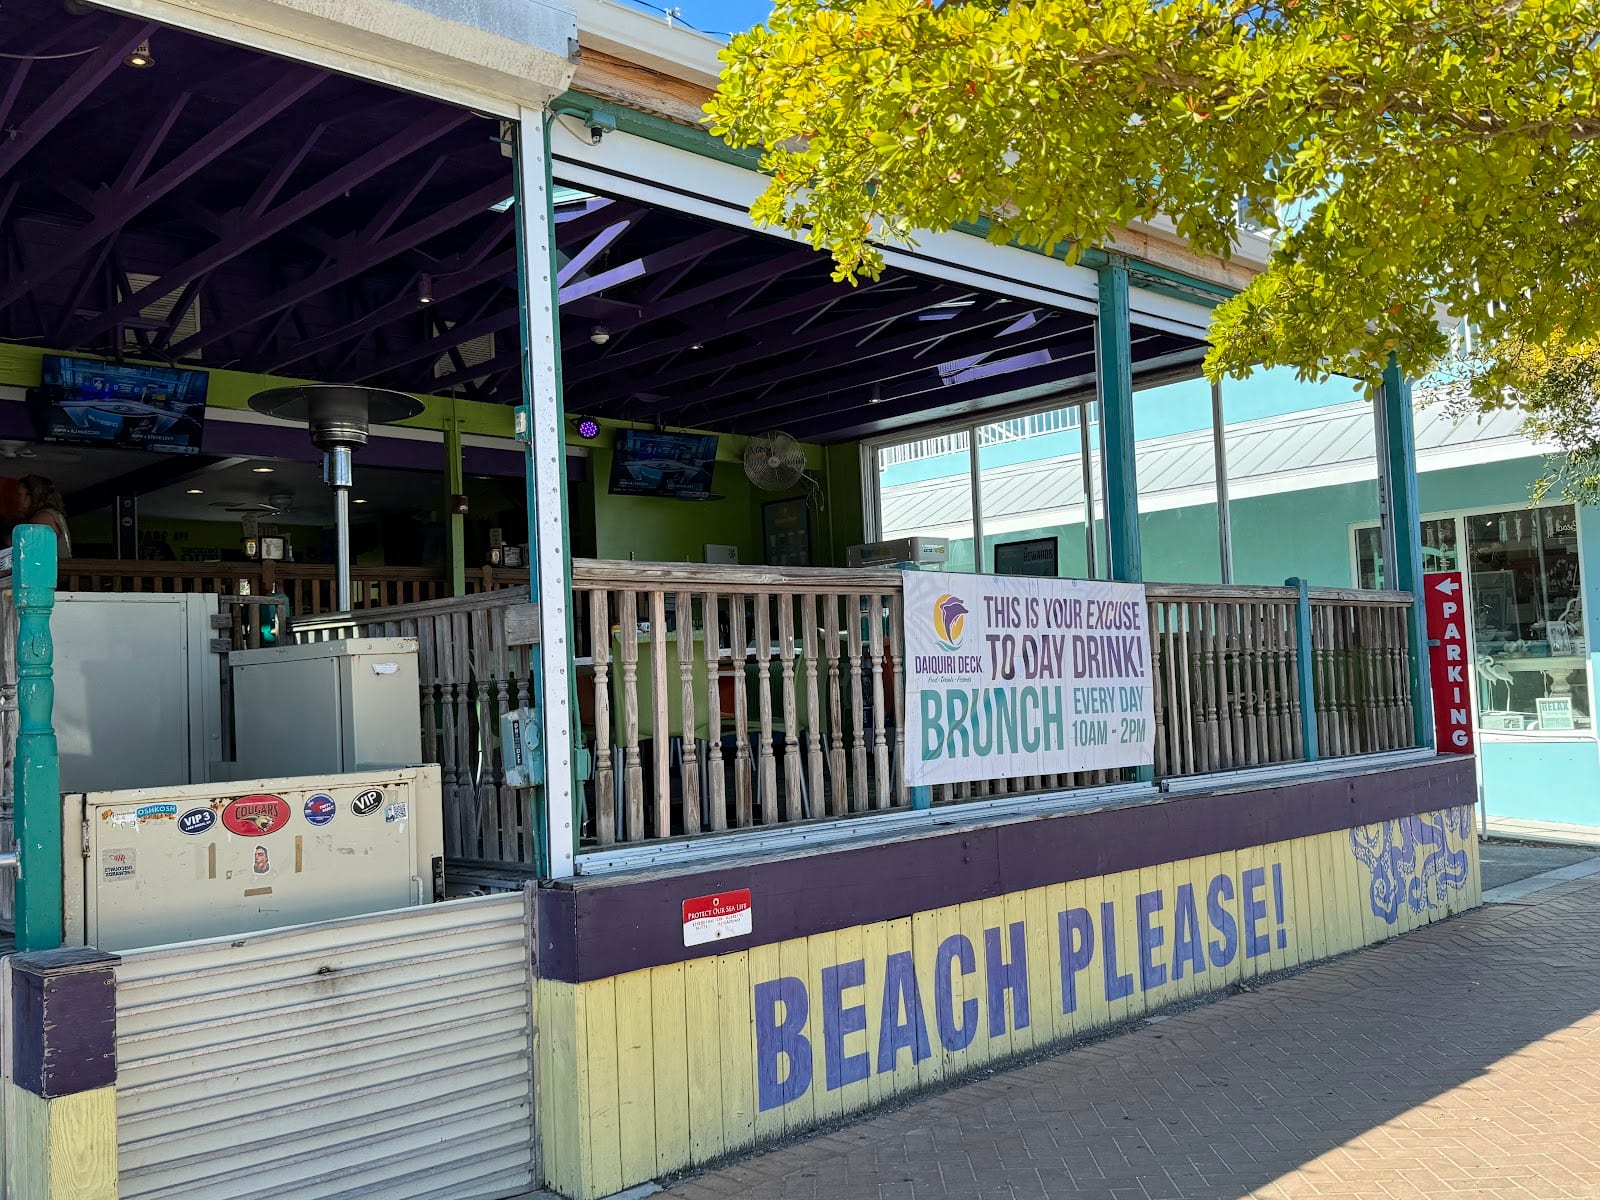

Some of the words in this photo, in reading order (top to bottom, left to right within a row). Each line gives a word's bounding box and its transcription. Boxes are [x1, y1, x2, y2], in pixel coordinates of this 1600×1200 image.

[983, 595, 1021, 629] THIS
[1025, 597, 1040, 629] IS
[1043, 598, 1083, 630] YOUR
[1086, 600, 1141, 631] EXCUSE
[914, 655, 956, 674] DAIQUIRI
[958, 655, 983, 673] DECK
[986, 634, 1016, 681] TO
[1022, 634, 1066, 680] DAY
[1072, 635, 1145, 679] DRINK!
[1442, 602, 1469, 747] PARKING
[1073, 686, 1116, 715] EVERY
[1120, 686, 1144, 713] DAY
[1541, 702, 1569, 712] RELAX
[920, 685, 1065, 761] BRUNCH
[1072, 719, 1108, 747] 10AM
[1120, 717, 1146, 744] 2PM
[137, 804, 177, 816] OSHKOSH
[235, 803, 279, 820] COUGARS
[355, 791, 377, 809] VIP
[184, 814, 203, 826] VIP
[203, 811, 211, 821] 3
[754, 920, 1031, 1113] BEACH
[1058, 862, 1289, 1015] PLEASE!
